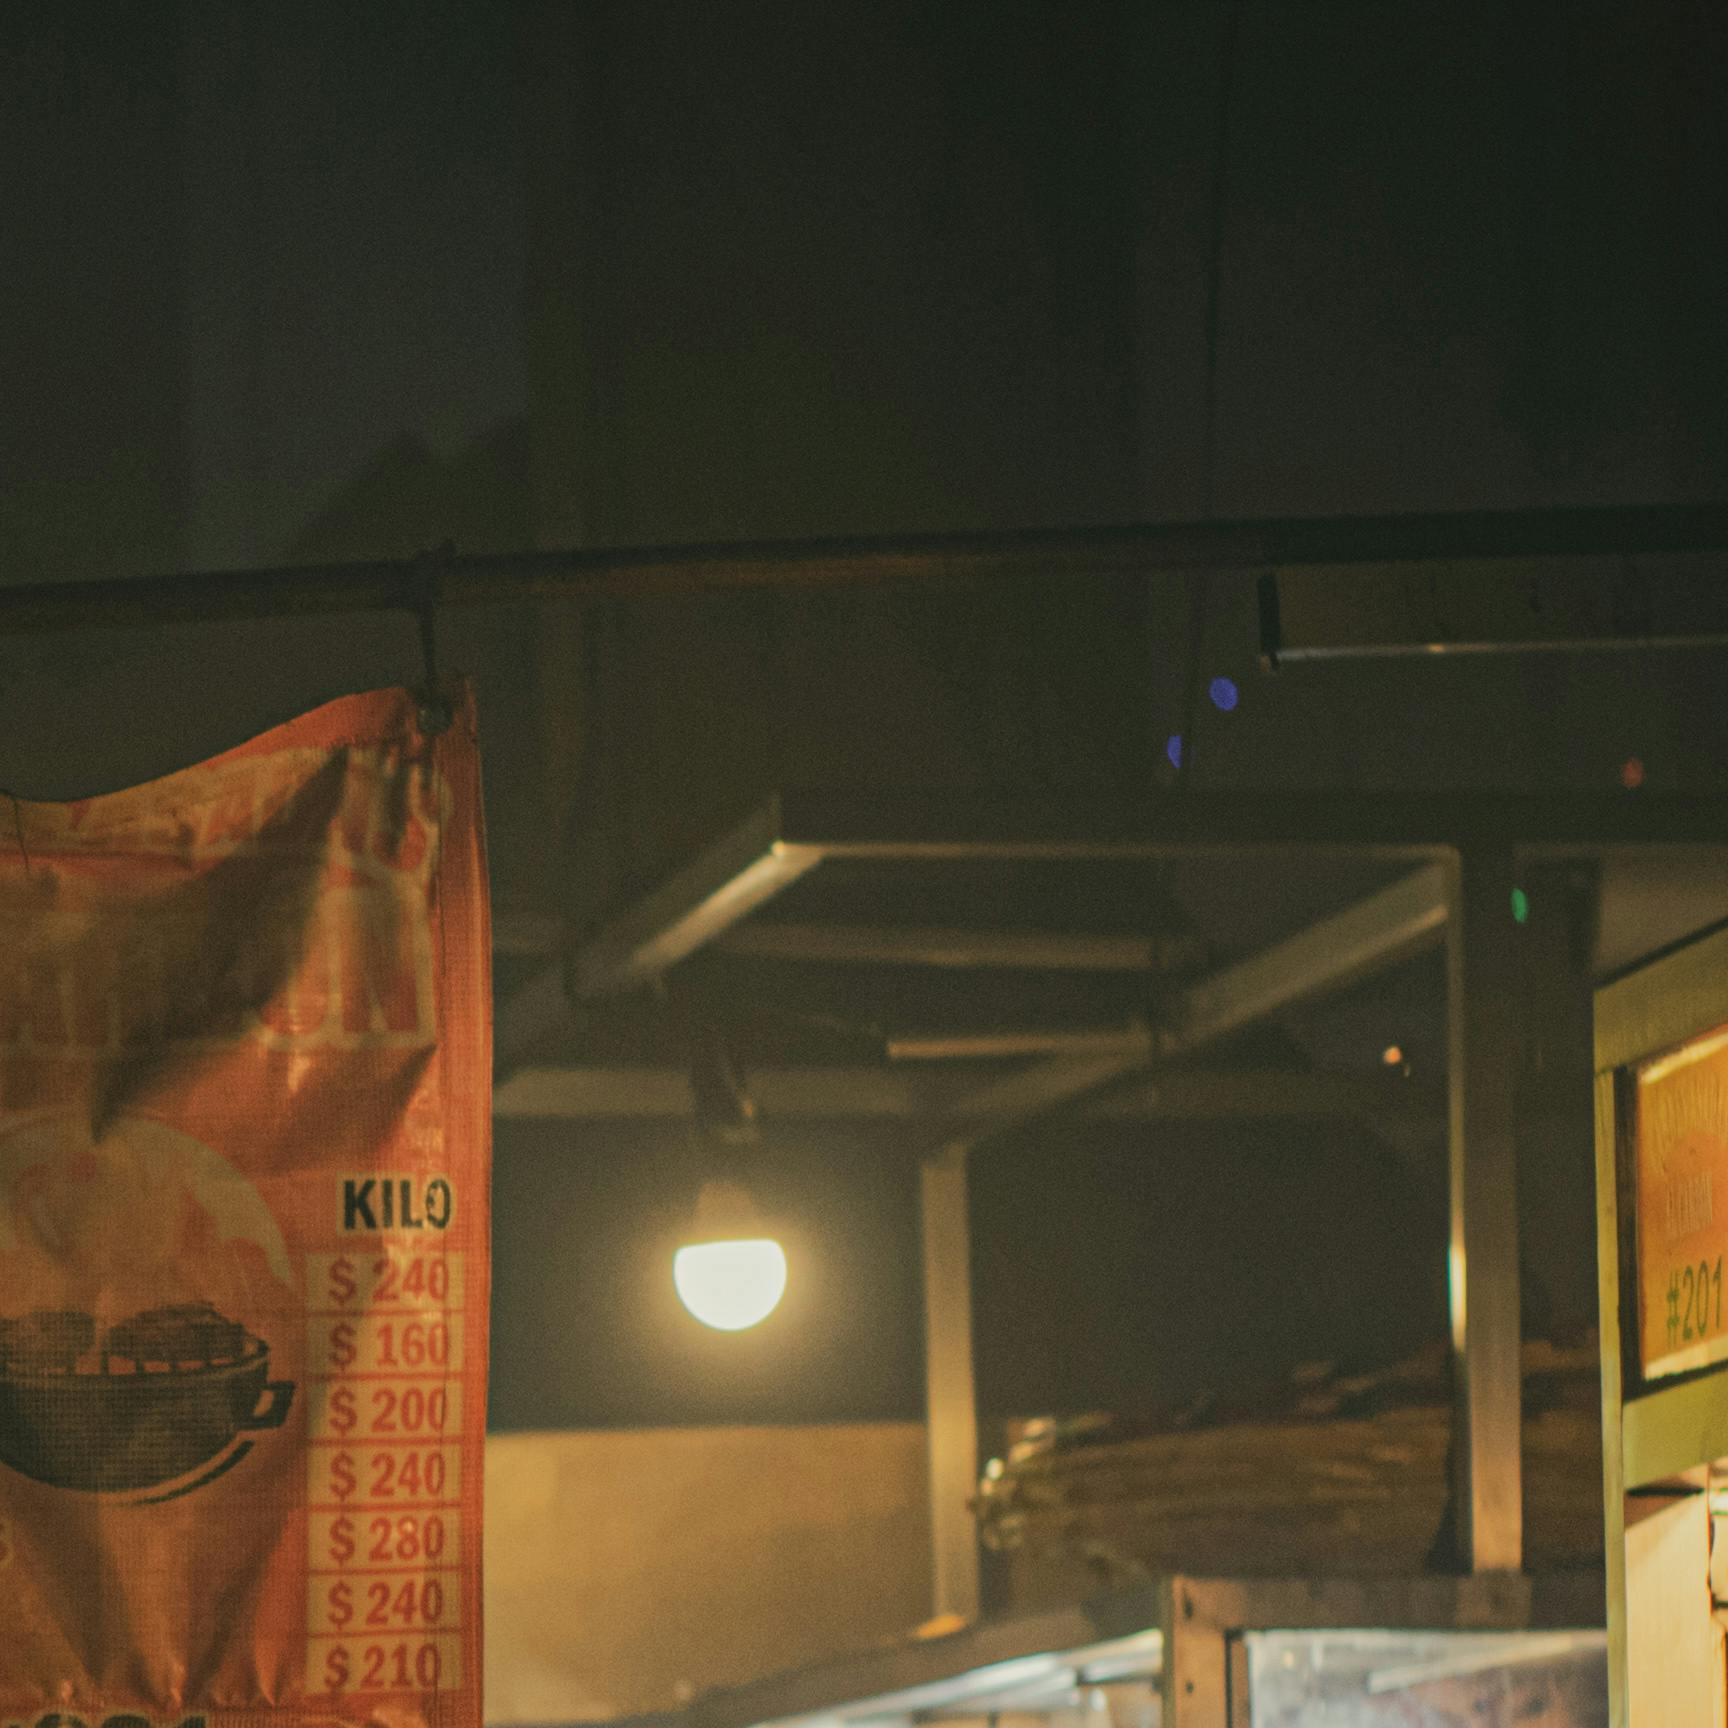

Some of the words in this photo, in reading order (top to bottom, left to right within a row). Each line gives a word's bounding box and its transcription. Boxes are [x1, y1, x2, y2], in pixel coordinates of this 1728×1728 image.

[345, 1177, 455, 1232] KILO
[328, 1260, 359, 1306] $
[373, 1258, 450, 1300] 240
[1664, 1253, 1724, 1349] #201
[328, 1321, 358, 1369] $
[375, 1321, 450, 1366] 160
[328, 1388, 358, 1434] $
[370, 1388, 449, 1432] 200
[328, 1453, 358, 1501] $
[368, 1451, 448, 1497] 240
[328, 1518, 358, 1565] $
[366, 1516, 446, 1562] 280
[326, 1581, 356, 1628] $
[365, 1579, 446, 1626] 240
[324, 1645, 353, 1692] $
[361, 1643, 443, 1691] 210
